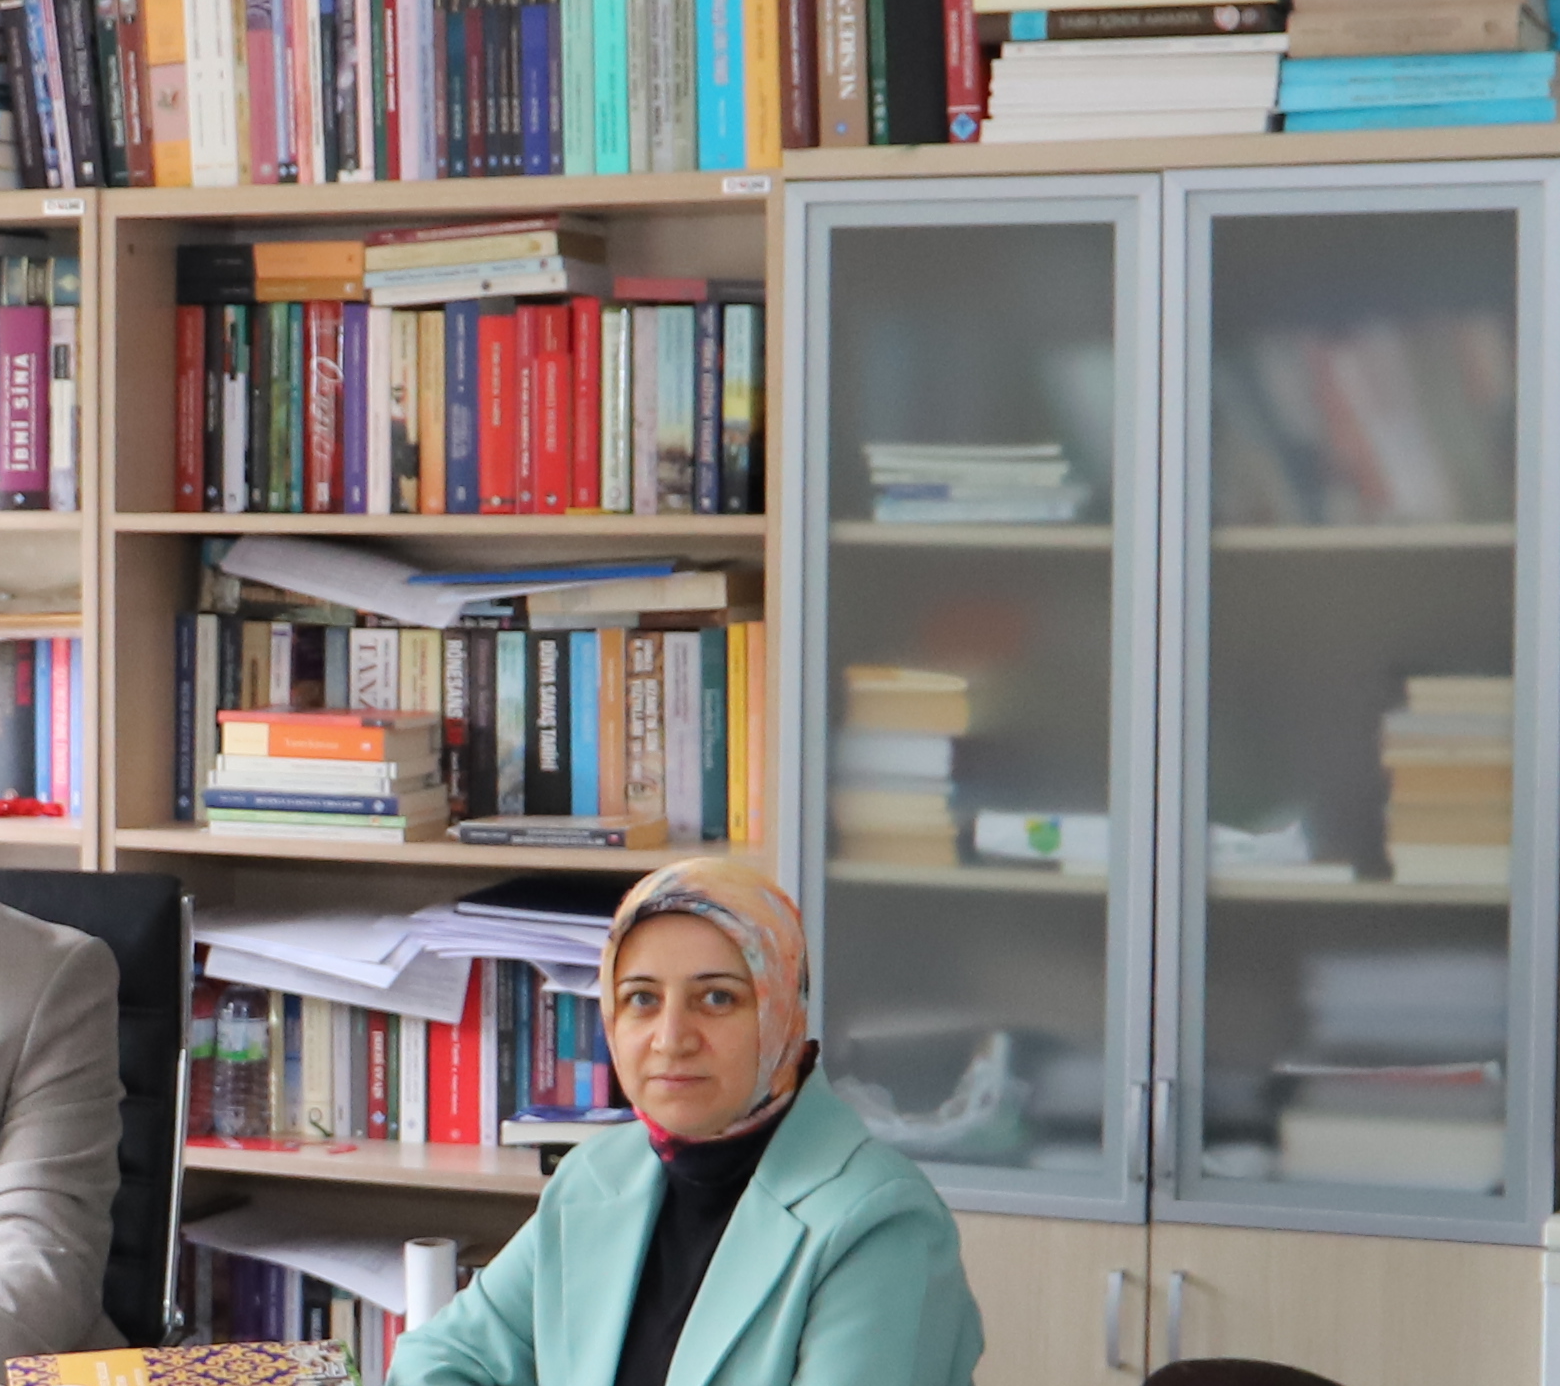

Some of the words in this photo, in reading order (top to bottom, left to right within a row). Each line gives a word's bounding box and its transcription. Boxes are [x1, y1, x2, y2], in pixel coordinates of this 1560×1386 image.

[445, 639, 468, 718] RÖNESANS
[538, 640, 559, 683] DÜNYA
[536, 685, 557, 727] SAVAŞ
[539, 728, 559, 772] TARİHİ
